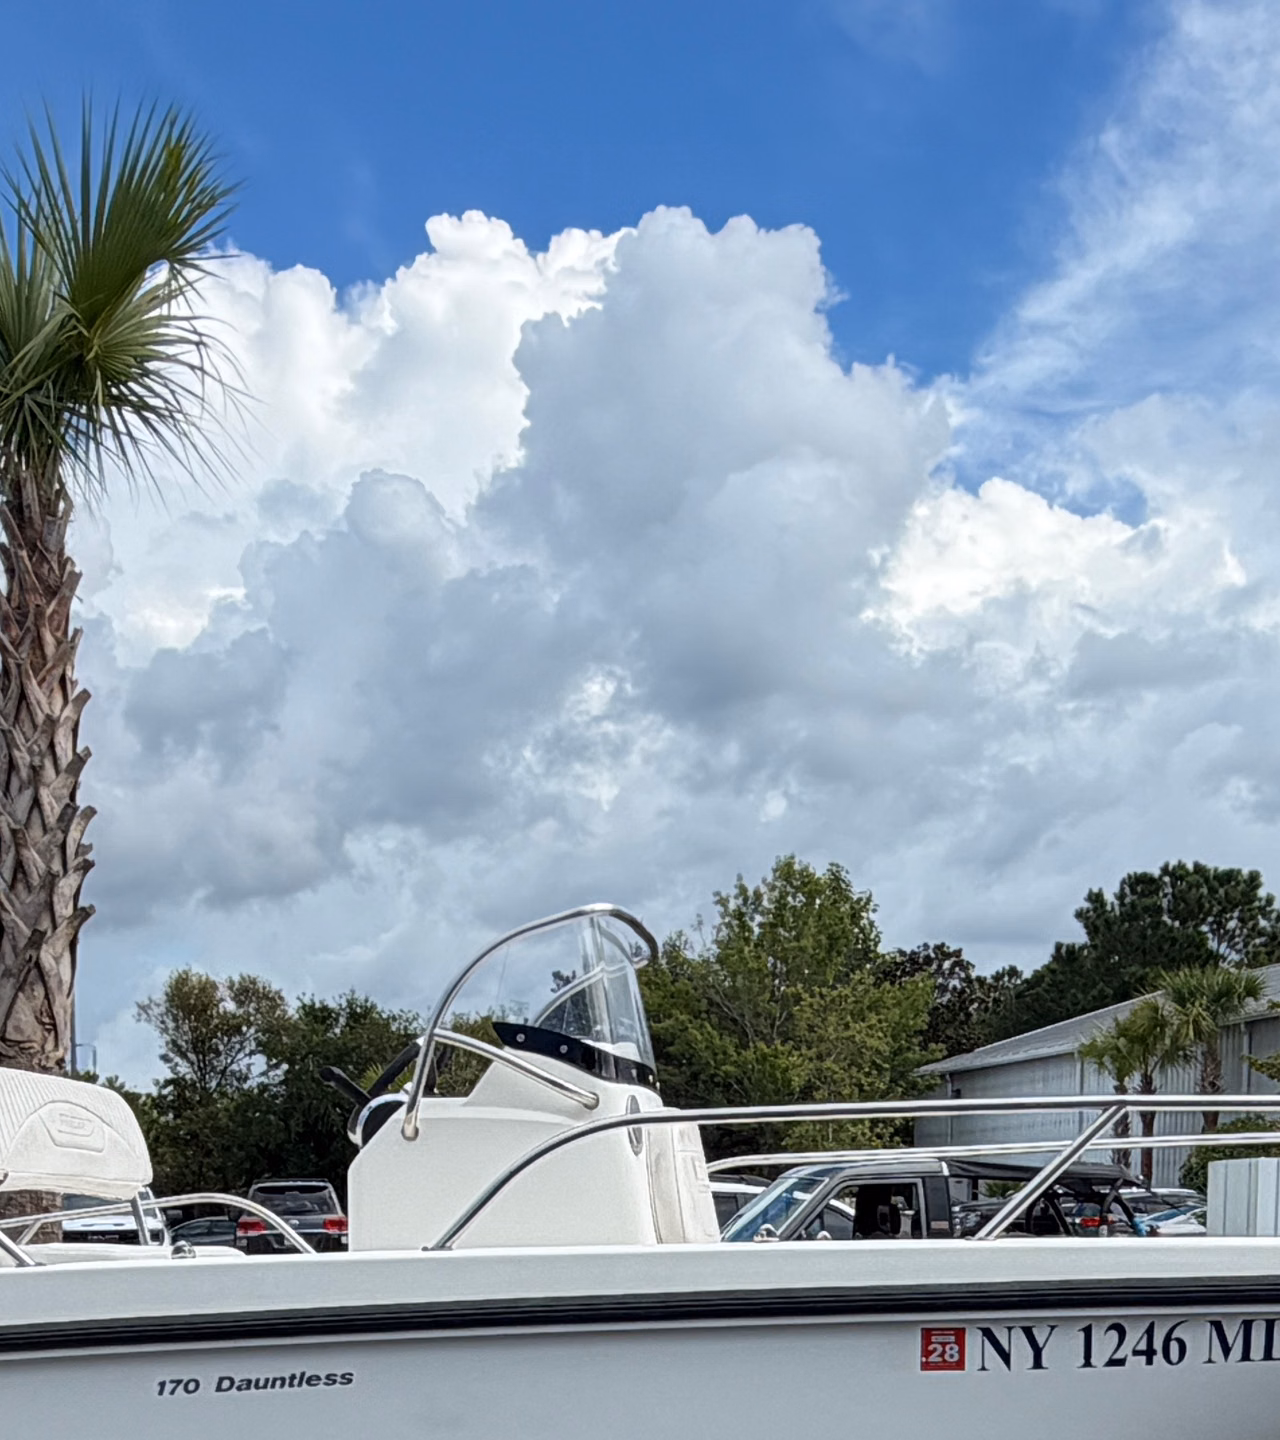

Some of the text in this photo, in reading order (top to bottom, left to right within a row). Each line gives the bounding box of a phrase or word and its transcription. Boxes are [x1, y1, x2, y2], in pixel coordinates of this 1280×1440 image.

[976, 1324, 1059, 1371] NY
[1077, 1319, 1189, 1369] 1246
[157, 1371, 354, 1396] 170 Dauntless
